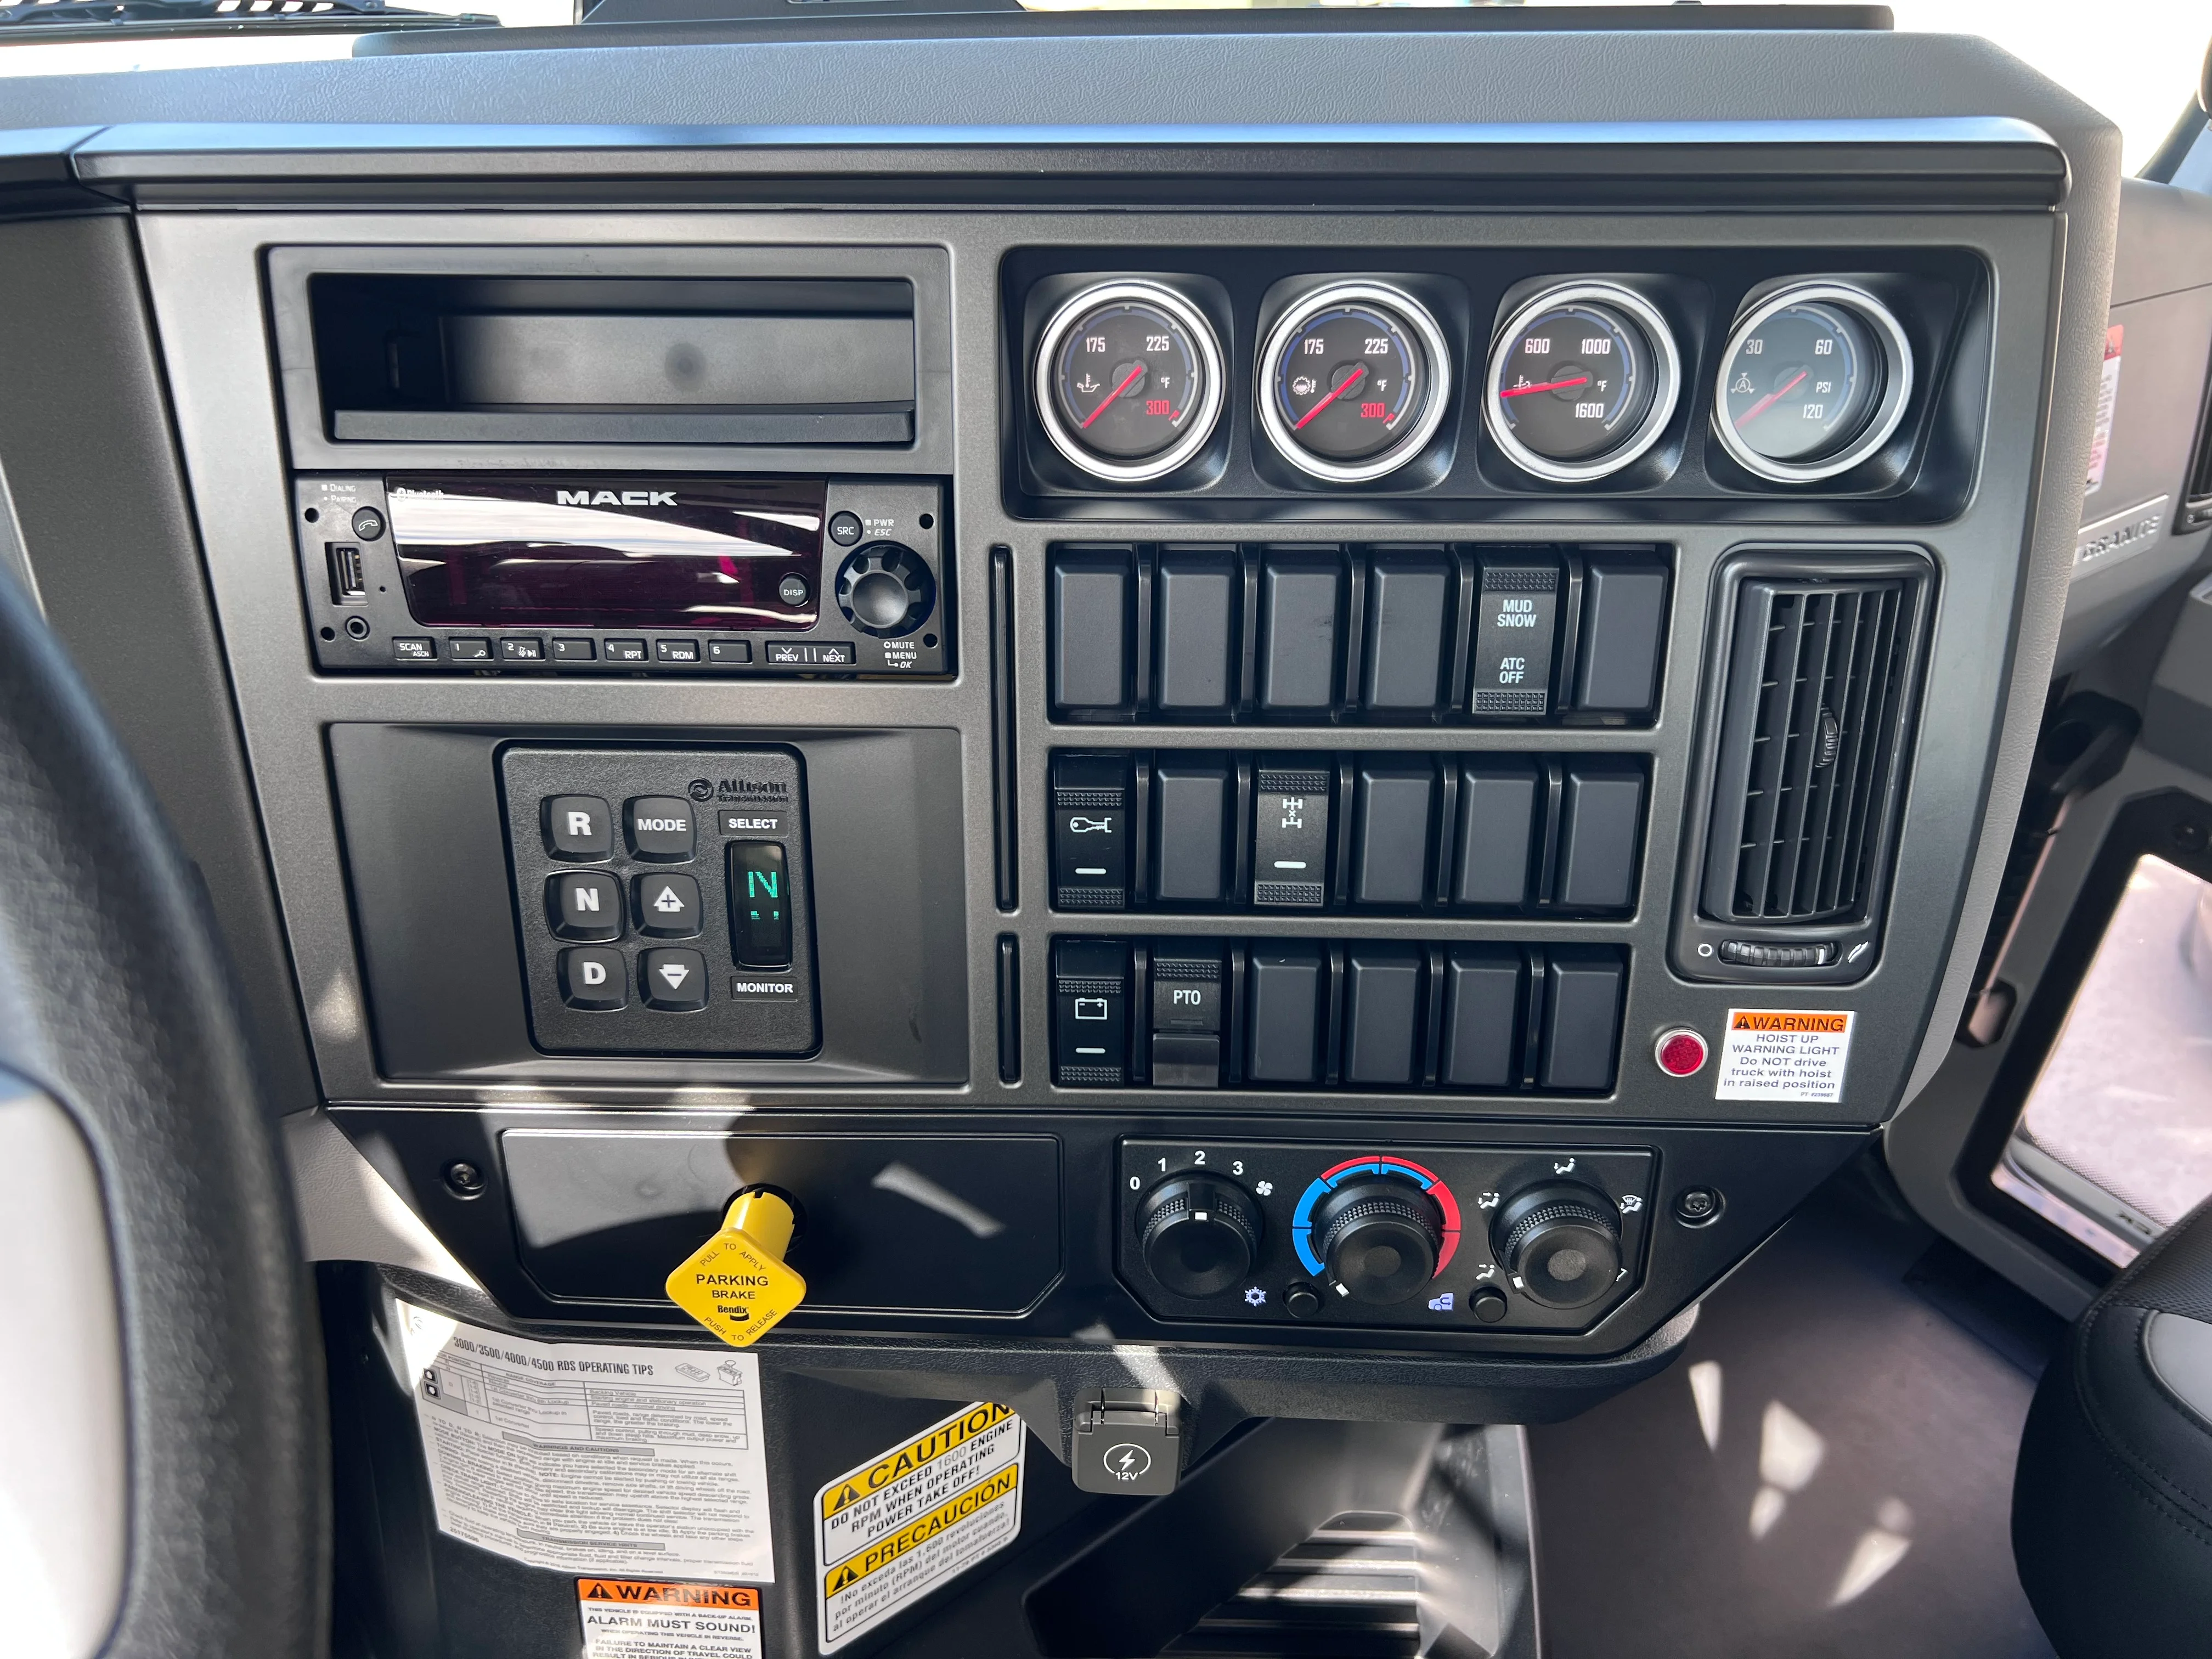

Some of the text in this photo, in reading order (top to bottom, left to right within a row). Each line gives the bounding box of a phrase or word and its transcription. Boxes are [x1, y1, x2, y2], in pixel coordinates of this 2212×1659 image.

[1086, 338, 1105, 352] 175
[1146, 336, 1169, 351] 225
[1304, 339, 1324, 354] 175
[1365, 339, 1389, 354] 225
[1525, 339, 1549, 354] 600
[1581, 339, 1610, 354] 1000
[1746, 339, 1763, 354] 30
[1815, 339, 1832, 354] 60
[1816, 382, 1831, 393] PSI
[1146, 400, 1169, 415] 300
[1361, 403, 1385, 417] 300
[1575, 403, 1604, 418] 1600
[1803, 404, 1823, 419] 120
[557, 490, 678, 506] MACK
[837, 527, 854, 535] SRC
[1503, 600, 1532, 613] MUD
[1497, 614, 1536, 627] SNOW
[558, 644, 565, 652] 3
[608, 644, 614, 652] 4
[625, 651, 641, 659] RPT
[661, 644, 667, 652] 5
[713, 646, 720, 654] 6
[1500, 658, 1525, 670] ATC
[1499, 672, 1524, 684] OFF
[718, 778, 788, 794] Allison
[568, 811, 592, 836] R
[638, 819, 687, 831] MODE
[729, 818, 778, 830] SELECT
[748, 871, 778, 898] N
[575, 888, 600, 912] N
[584, 962, 606, 985] D
[737, 983, 793, 994] MONITOR
[1173, 990, 1201, 1005] PTO
[1752, 1017, 1844, 1031] WARNING
[1756, 1034, 1819, 1043] HOIST UP
[1733, 1045, 1839, 1055] WARNING LIGHT
[1740, 1057, 1757, 1065] Do
[1794, 1058, 1826, 1066] drive
[1731, 1068, 1832, 1078] truck with hoist
[1739, 1079, 1779, 1087] raised
[1782, 1080, 1835, 1089] position
[1158, 1158, 1166, 1172] 1
[1194, 1150, 1206, 1165] 2
[1233, 1161, 1243, 1175] 3
[1130, 1176, 1141, 1190] 0
[700, 1250, 720, 1267] PULL
[739, 1251, 766, 1271] APPLY
[696, 1274, 769, 1286] PARKING
[712, 1290, 755, 1299] BRAKE
[718, 1305, 748, 1314] Bendix
[704, 1317, 726, 1335] PUSH
[746, 1309, 777, 1336] RELEASE
[454, 1336, 554, 1371] 3000/3500/4000/4500
[557, 1360, 575, 1371] RDS
[579, 1361, 630, 1374] OPERATING
[632, 1364, 654, 1375] TIPS
[868, 1403, 1010, 1488] CAUTION
[832, 1419, 1013, 1530] DO NOT EXCEED 1600 ENGINE
[1115, 1472, 1138, 1480] 12V
[851, 1444, 995, 1532] RPM WHEN OPERATING
[868, 1465, 980, 1537] POWER TAKE OFF!
[866, 1472, 1010, 1572] PRECAUCIÓN
[861, 1565, 896, 1592] exceda
[899, 1555, 913, 1569] las
[834, 1604, 851, 1620] por
[855, 1581, 889, 1607] minuto
[891, 1561, 923, 1586] (RPM)
[925, 1549, 940, 1564] del
[616, 1584, 751, 1606] WARNING
[833, 1622, 843, 1632] al
[846, 1600, 878, 1624] operar
[587, 1615, 755, 1633] ALARM MUST SOUND!
